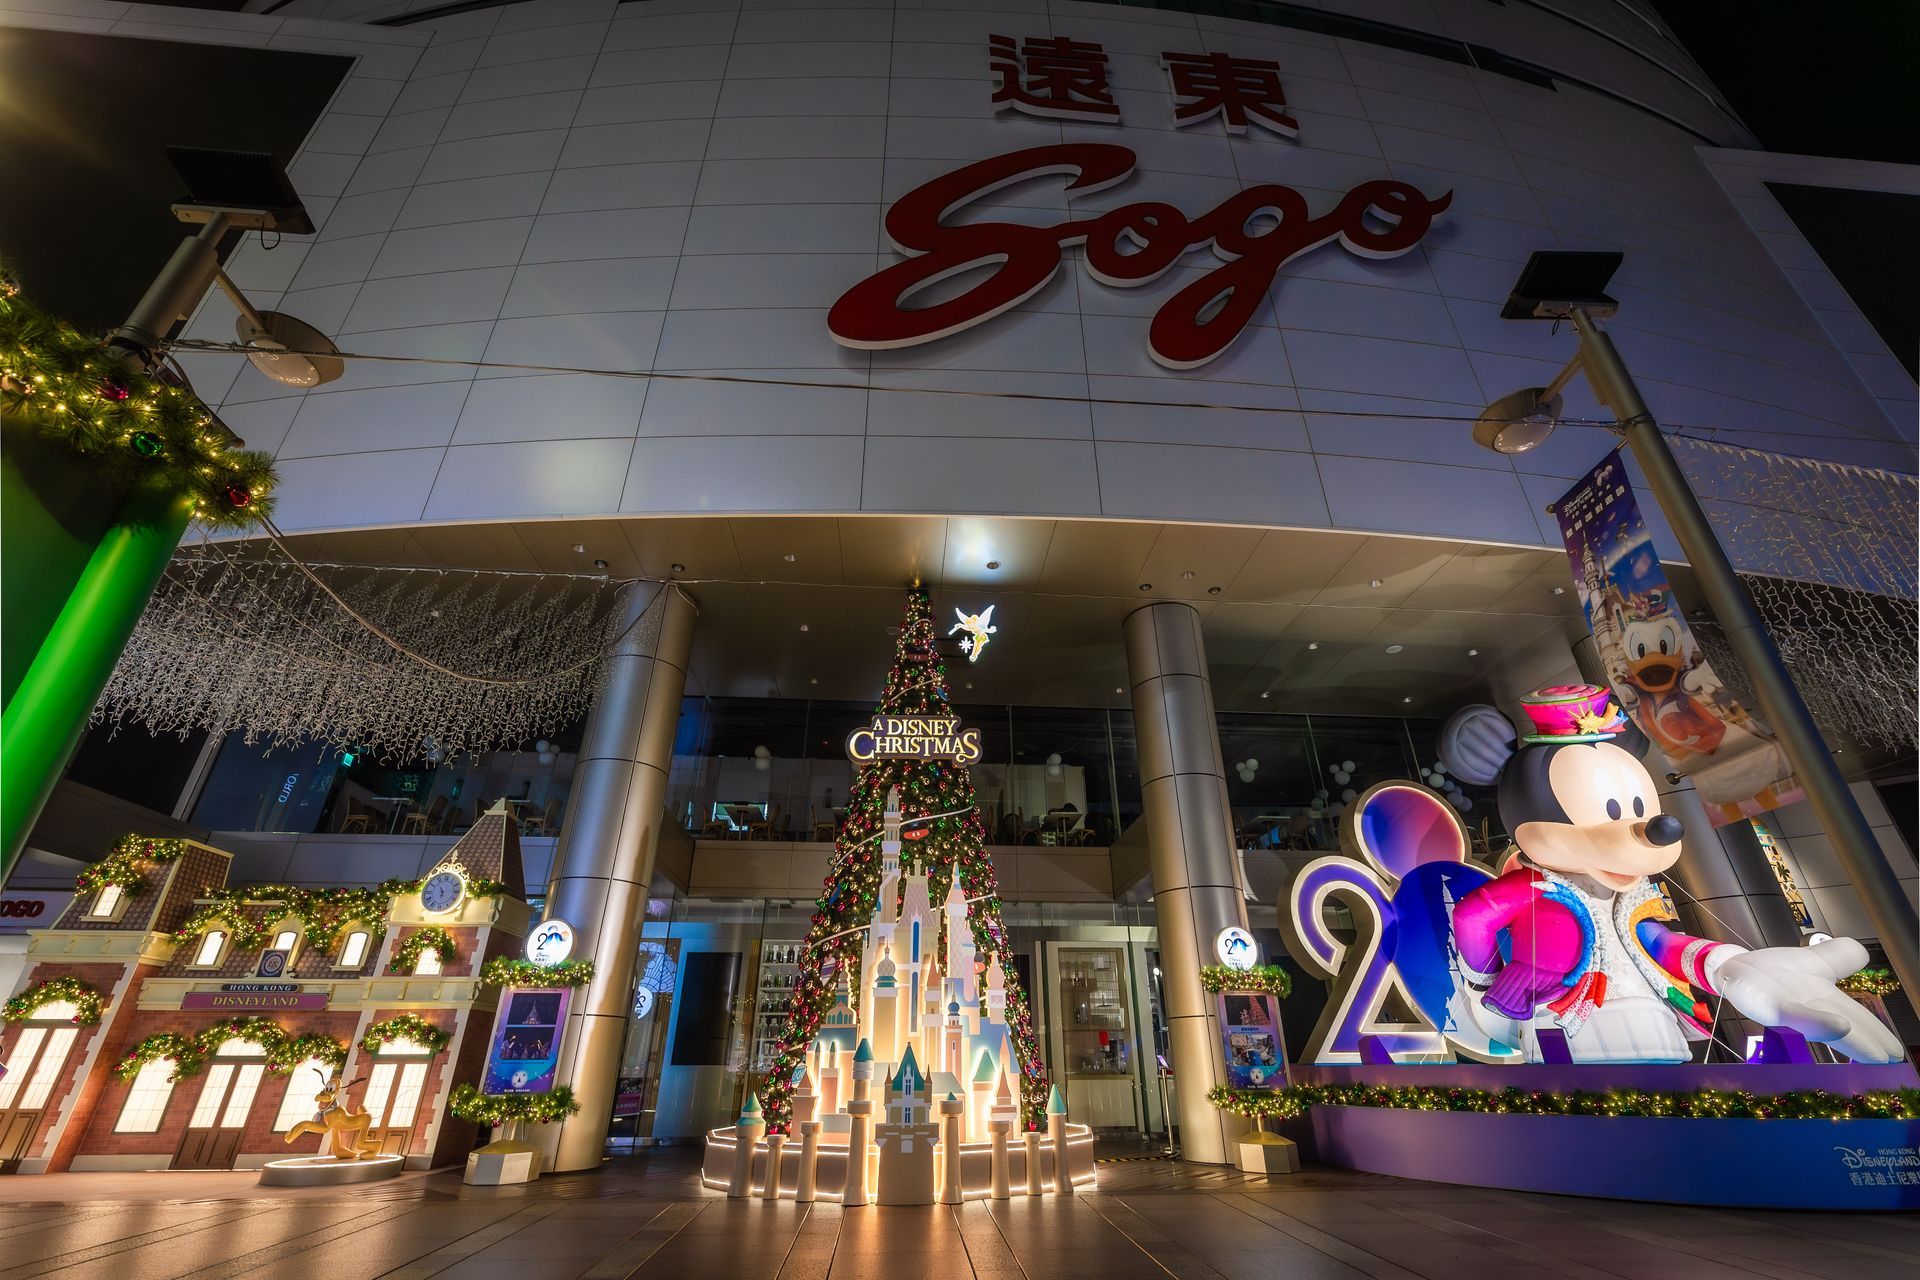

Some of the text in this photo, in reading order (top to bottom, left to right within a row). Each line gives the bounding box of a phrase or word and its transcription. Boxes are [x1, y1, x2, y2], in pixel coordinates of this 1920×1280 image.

[988, 33, 1300, 138] 遠東
[826, 142, 1454, 371] Sogo
[873, 718, 958, 736] A DISNEY
[849, 731, 979, 763] CHRISTMAS
[1, 900, 45, 918] OGO
[212, 996, 299, 1006] DISNEYLAND
[1848, 1171, 1920, 1187] 香港迪士尼樂
